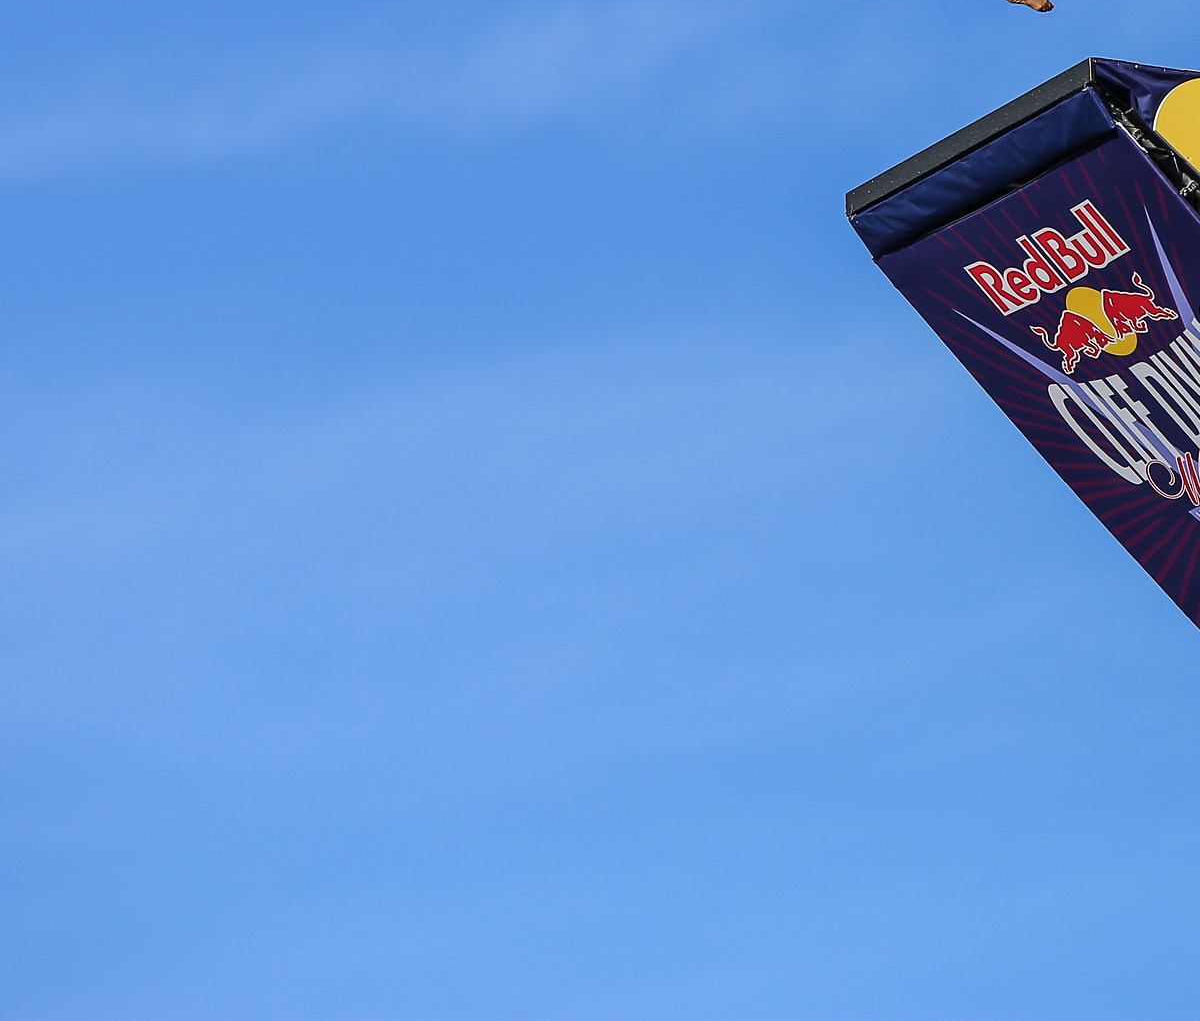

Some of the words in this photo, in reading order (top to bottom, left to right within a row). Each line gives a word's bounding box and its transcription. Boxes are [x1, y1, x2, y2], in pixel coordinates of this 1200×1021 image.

[963, 234, 1067, 316] Red
[1031, 199, 1131, 283] Bull
[1048, 374, 1186, 484] CLIFF
